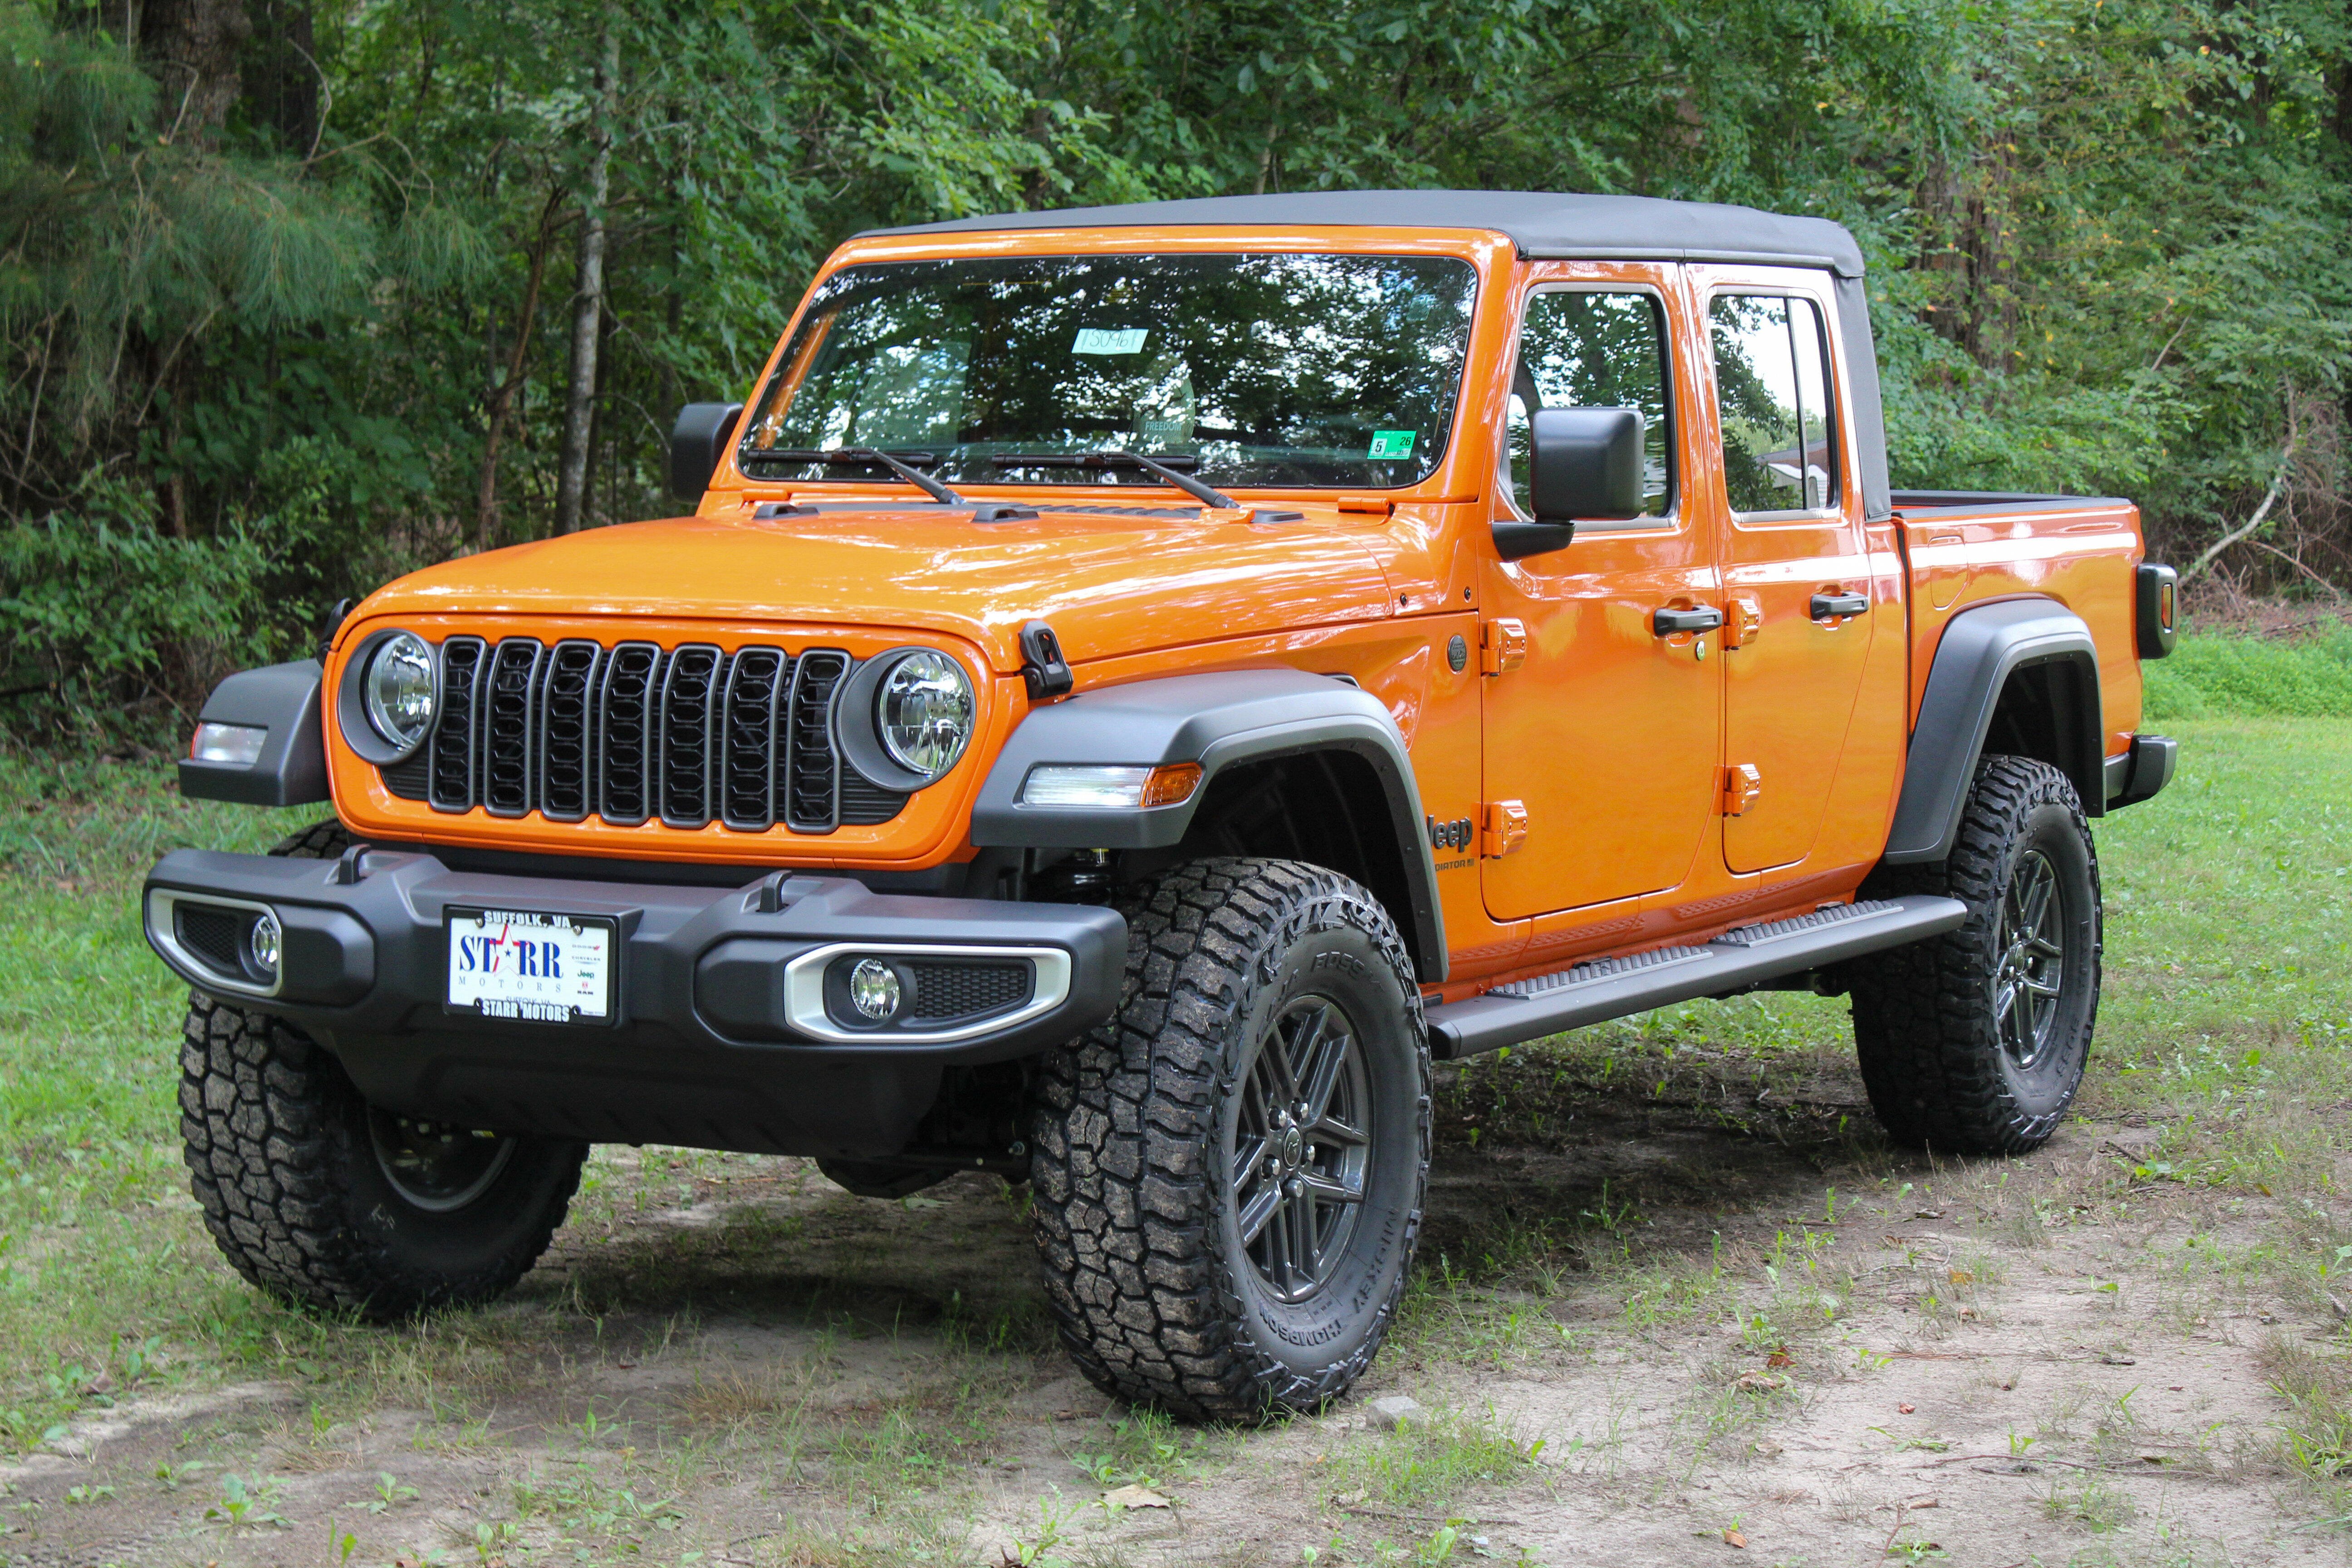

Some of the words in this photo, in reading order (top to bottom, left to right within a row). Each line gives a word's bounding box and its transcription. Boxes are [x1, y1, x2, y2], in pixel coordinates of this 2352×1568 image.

[1145, 421, 1182, 431] FREEDOM
[1375, 441, 1383, 452] 5
[1400, 436, 1412, 446] 26
[1435, 860, 1465, 871] DIATOR
[484, 911, 547, 927] SUFFOLK,
[552, 915, 572, 928] VA
[577, 969, 594, 980] Jeep
[458, 976, 562, 993] MOTORS
[481, 999, 519, 1019] STARR
[521, 1003, 571, 1023] MOTORS
